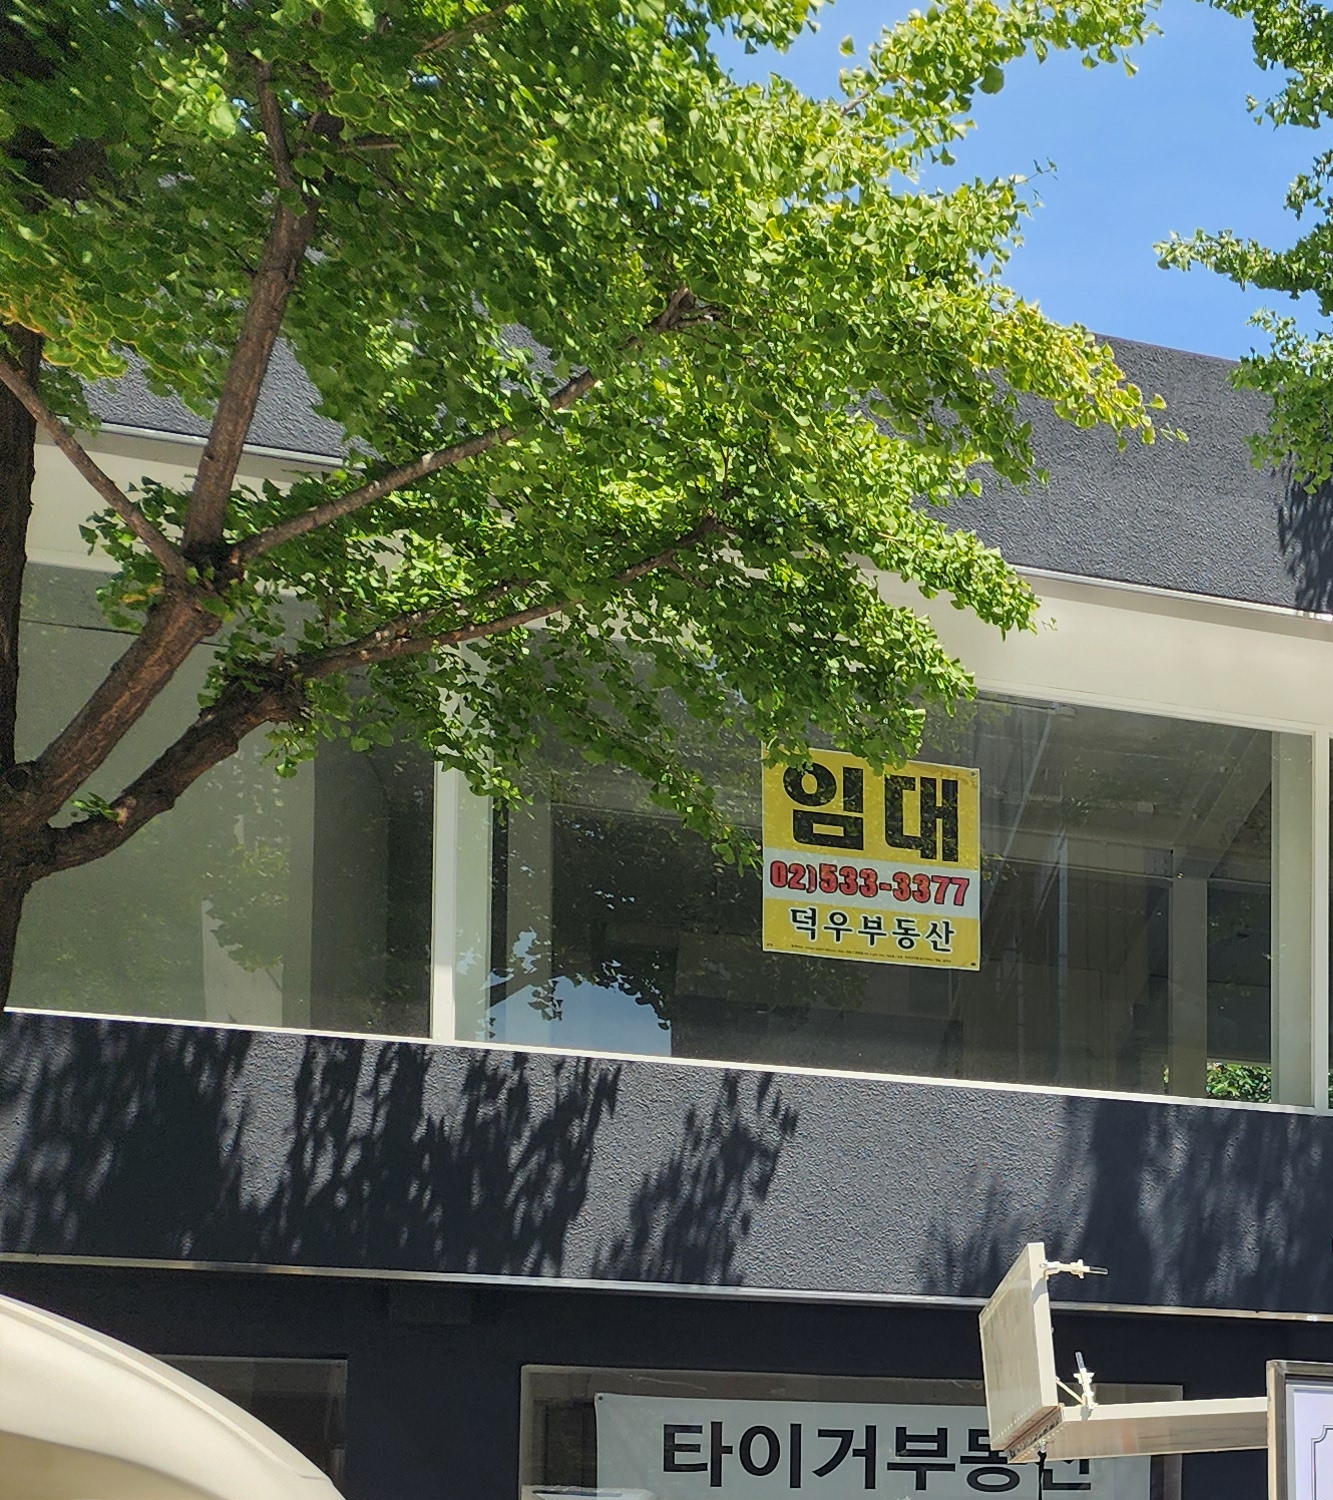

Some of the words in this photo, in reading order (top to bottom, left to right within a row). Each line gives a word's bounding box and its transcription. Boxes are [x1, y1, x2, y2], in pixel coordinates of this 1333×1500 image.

[783, 762, 959, 863] 임대
[769, 859, 970, 907] 02)533-3377
[790, 906, 956, 953] 덕우부동산
